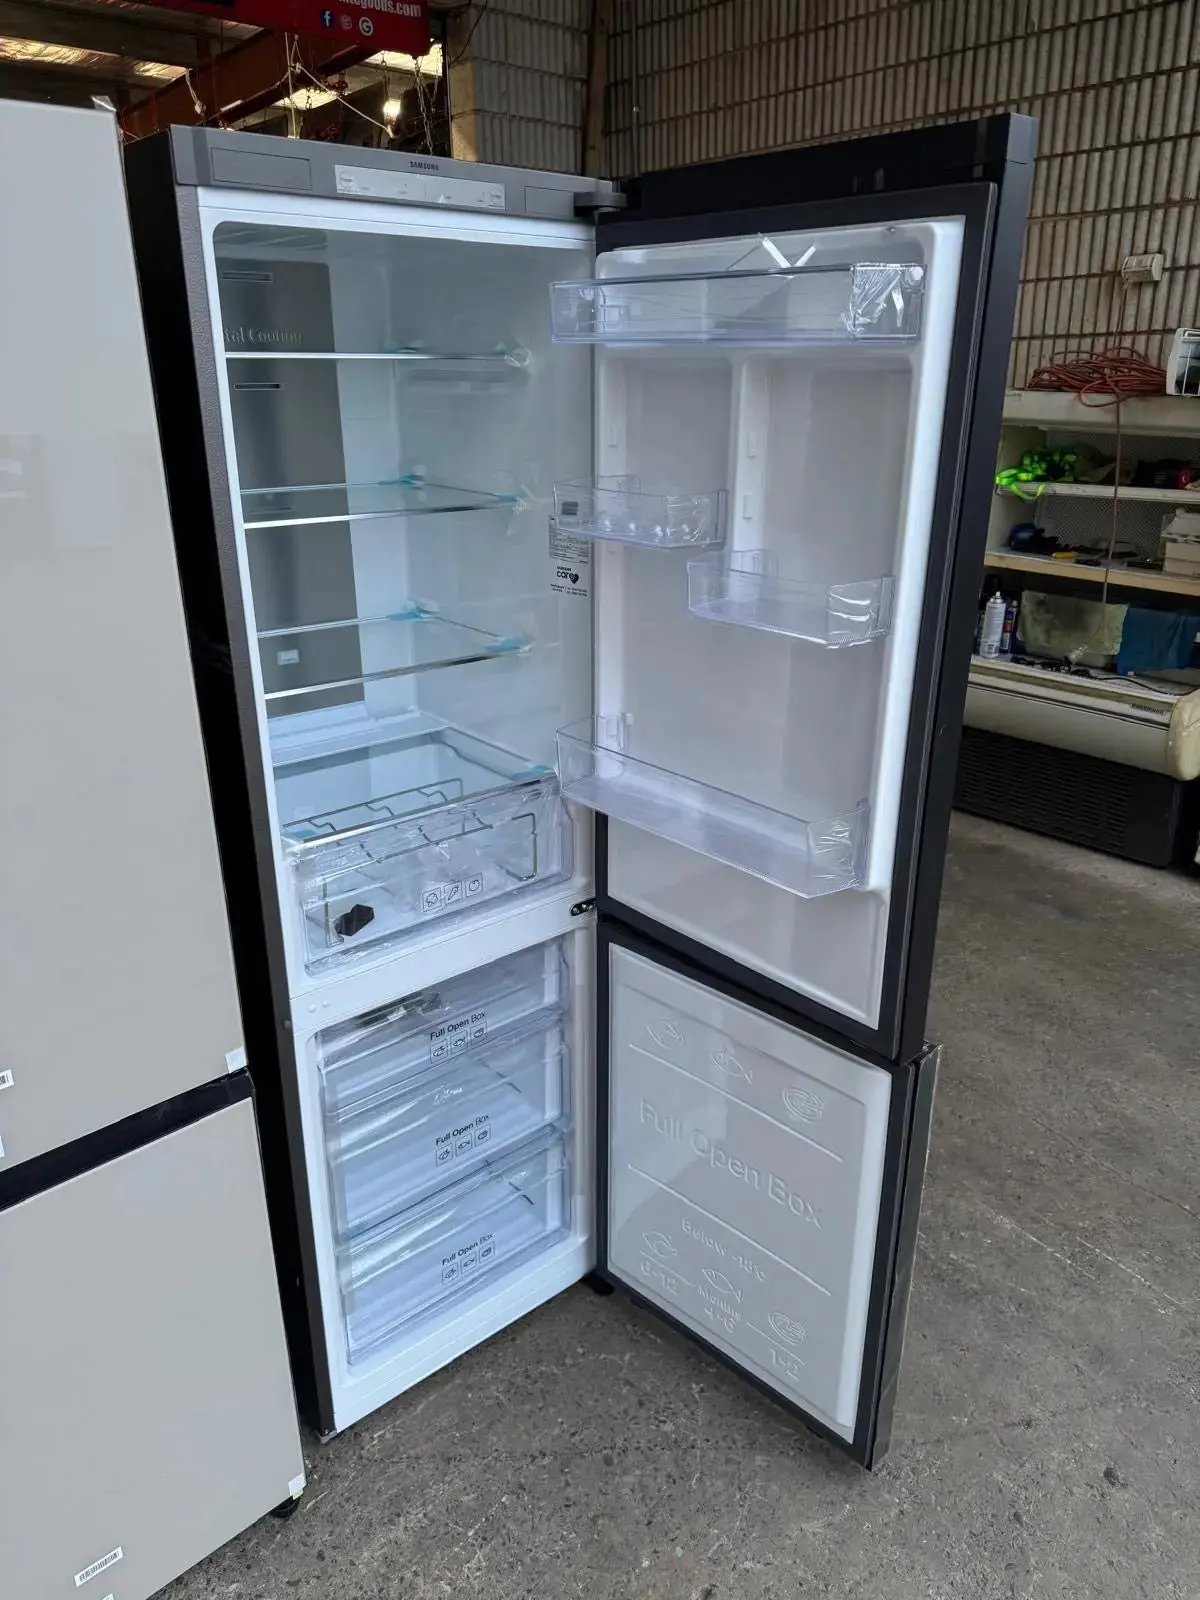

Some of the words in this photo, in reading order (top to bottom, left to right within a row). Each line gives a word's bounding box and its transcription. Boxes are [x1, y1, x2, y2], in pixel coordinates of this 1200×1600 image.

[338, 0, 422, 17] goods.com
[409, 160, 440, 171] SAMSUNG
[429, 1027, 446, 1040] Full
[446, 1018, 470, 1033] Open
[470, 1010, 487, 1023] Box
[435, 1132, 451, 1146] Full
[452, 1122, 474, 1137] Open
[475, 1114, 490, 1126] Box
[638, 1098, 684, 1144] Full
[690, 1129, 761, 1190] Open
[767, 1173, 823, 1229] Box
[441, 1253, 457, 1266] Full
[457, 1241, 479, 1257] Open
[479, 1233, 494, 1245] Box
[680, 1215, 727, 1257] Below
